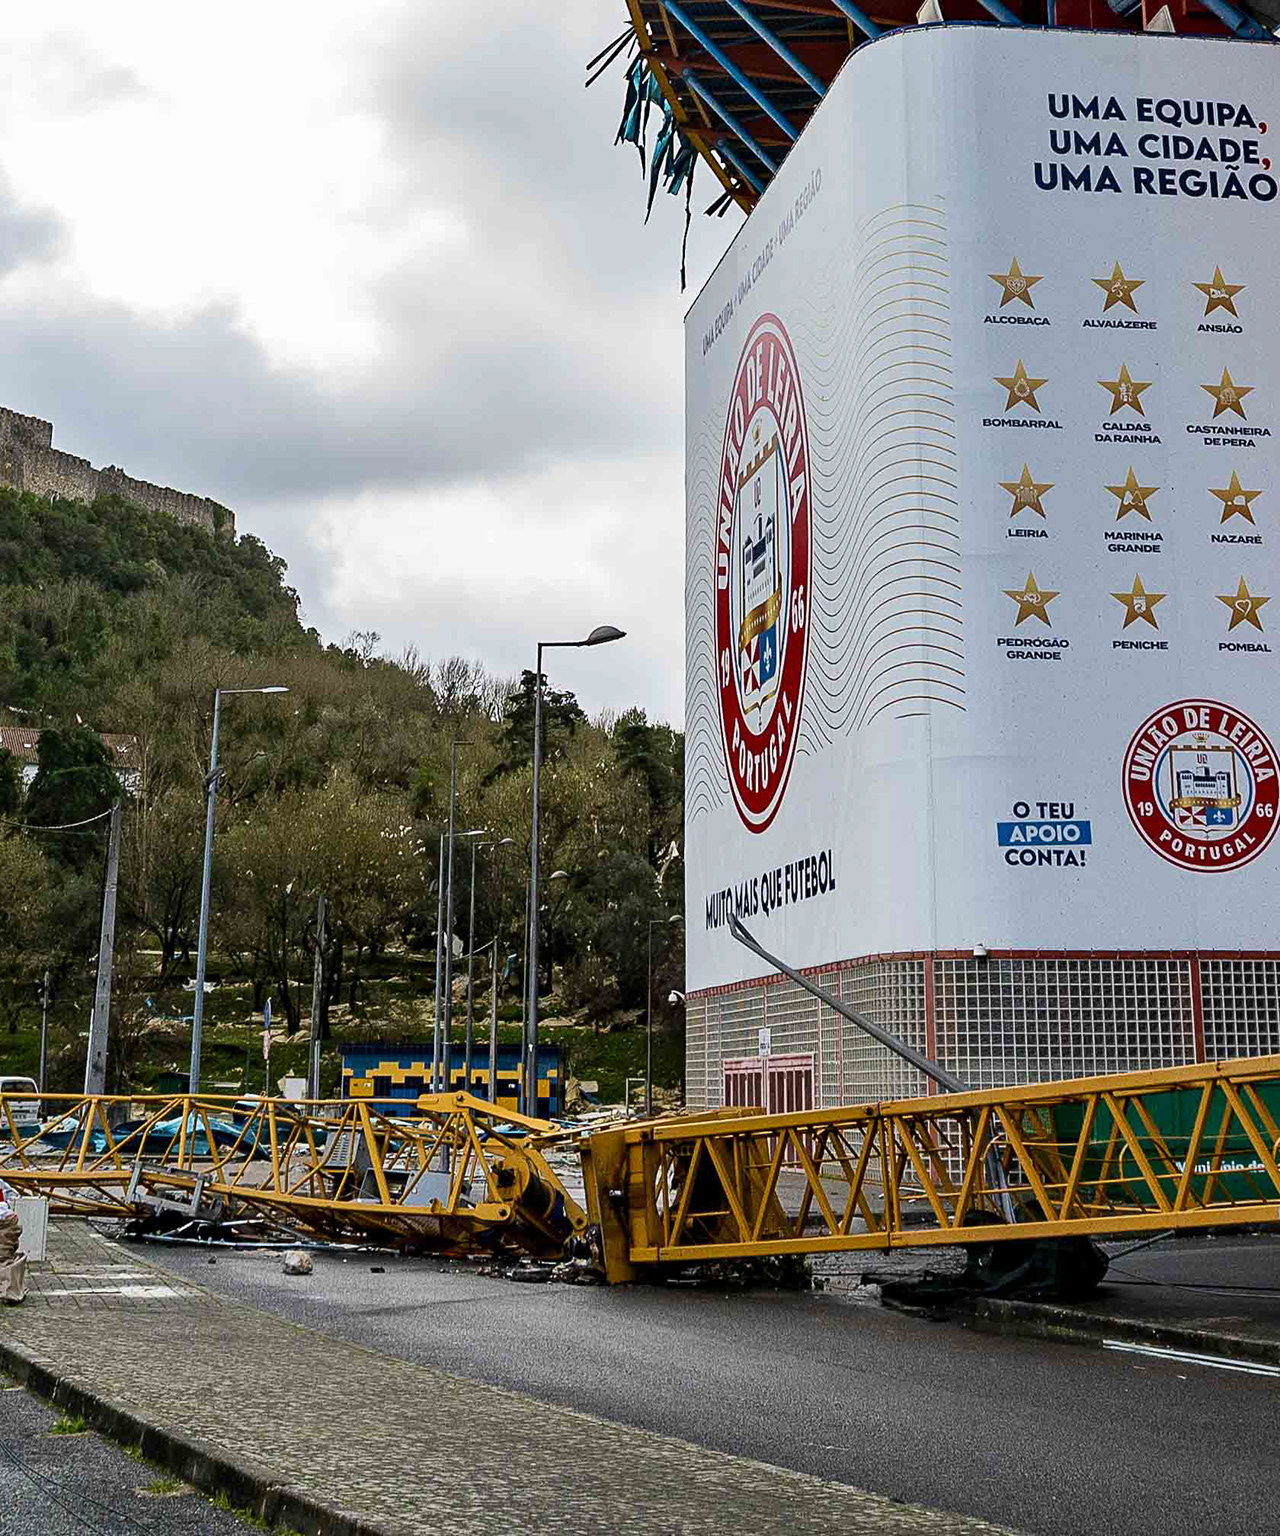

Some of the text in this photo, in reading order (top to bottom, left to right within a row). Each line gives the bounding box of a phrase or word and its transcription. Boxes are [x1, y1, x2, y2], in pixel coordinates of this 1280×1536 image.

[1048, 93, 1268, 134] UMA EQUIPA,
[1049, 129, 1271, 170] UMA CIDADE,
[1034, 162, 1122, 193] UMA
[1082, 318, 1157, 330] ALVAIÁZERE
[1197, 322, 1243, 334] ANSIÃO
[982, 418, 1063, 430] BOMBARRAL
[1102, 422, 1151, 432] CALDAS
[747, 341, 764, 414] DE
[768, 341, 806, 525] LEIRIA
[1186, 425, 1271, 437] CASTANHEIRA
[1095, 434, 1161, 445] DA RAINHA
[1204, 438, 1256, 448] DE PERA
[1008, 529, 1048, 539] LEIRIA
[1104, 531, 1163, 542] MARINHA
[1211, 533, 1262, 545] NAZARÉ
[1107, 543, 1161, 553] GRANDE
[791, 585, 805, 633] 66
[997, 637, 1069, 648] PEDRÓGÃO
[1112, 640, 1168, 651] PENICHE
[1218, 642, 1271, 653] POMBAL
[1006, 650, 1061, 660] GRANDE
[721, 647, 730, 688] 19
[732, 691, 792, 793] PORTUGAL
[1131, 707, 1275, 782] UNIÃO DE LEIRIA
[1013, 802, 1074, 818] O TEU
[1137, 802, 1154, 816] 19
[1255, 803, 1273, 817] 66
[1009, 825, 1081, 843] APOIO
[1159, 829, 1256, 860] PORTUGAL
[1005, 849, 1085, 867] CONTA!
[705, 849, 836, 931] MUITO MAIS QUE FUTEBOL
